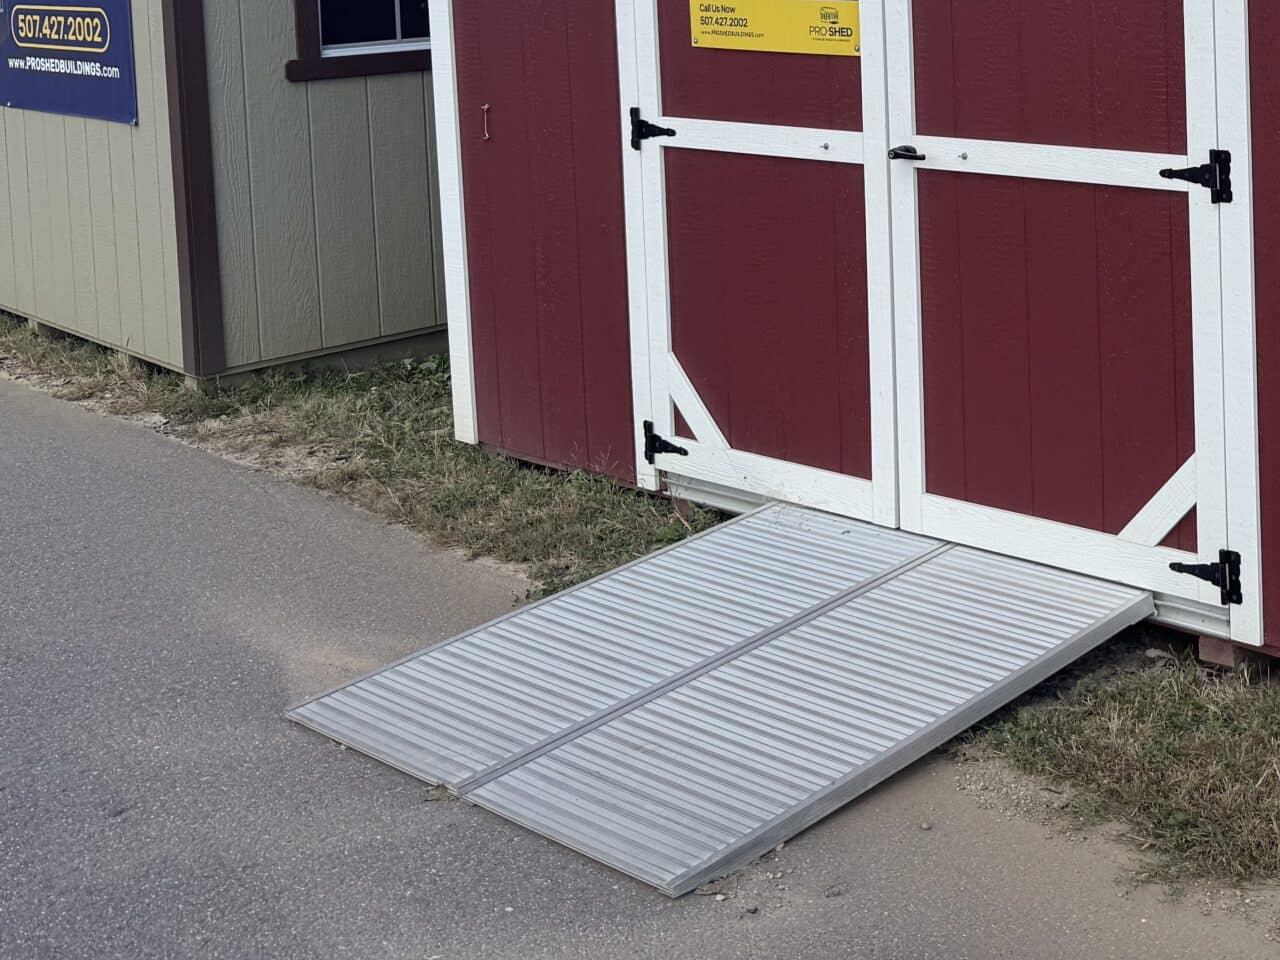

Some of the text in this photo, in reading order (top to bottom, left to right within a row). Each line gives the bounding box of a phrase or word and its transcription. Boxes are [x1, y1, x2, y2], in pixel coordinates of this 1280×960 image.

[699, 3, 736, 14] Call Us Now
[17, 14, 103, 43] 507.427.2002
[700, 15, 748, 28] 507.427.2002
[7, 56, 120, 79] www.PROSHEDBUILDINGS.com
